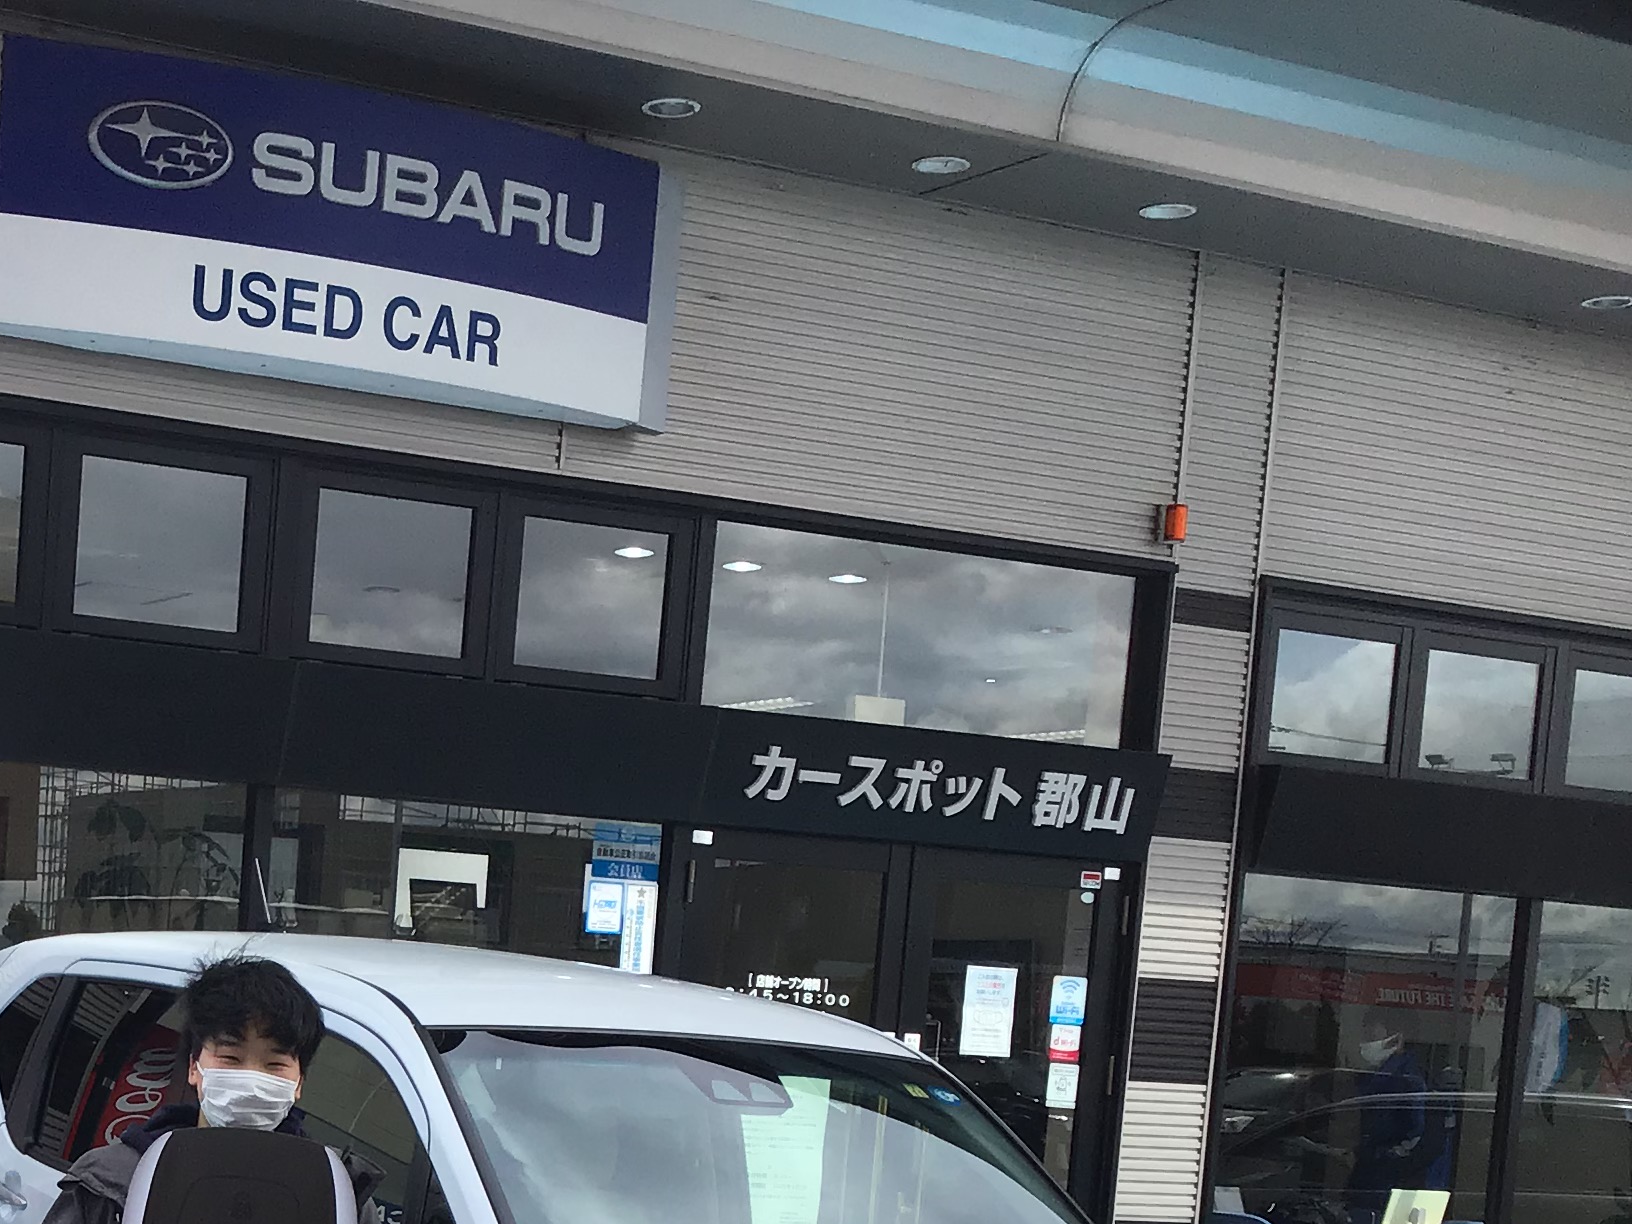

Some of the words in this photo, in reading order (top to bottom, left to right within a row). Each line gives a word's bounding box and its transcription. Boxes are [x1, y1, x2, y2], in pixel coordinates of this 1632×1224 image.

[251, 131, 605, 257] SUBARU
[191, 263, 363, 342] USED
[382, 295, 502, 367] CAR
[743, 744, 1023, 821] カースポット
[1031, 770, 1137, 835] 郡山
[1055, 1004, 1080, 1015] Wi-Fi
